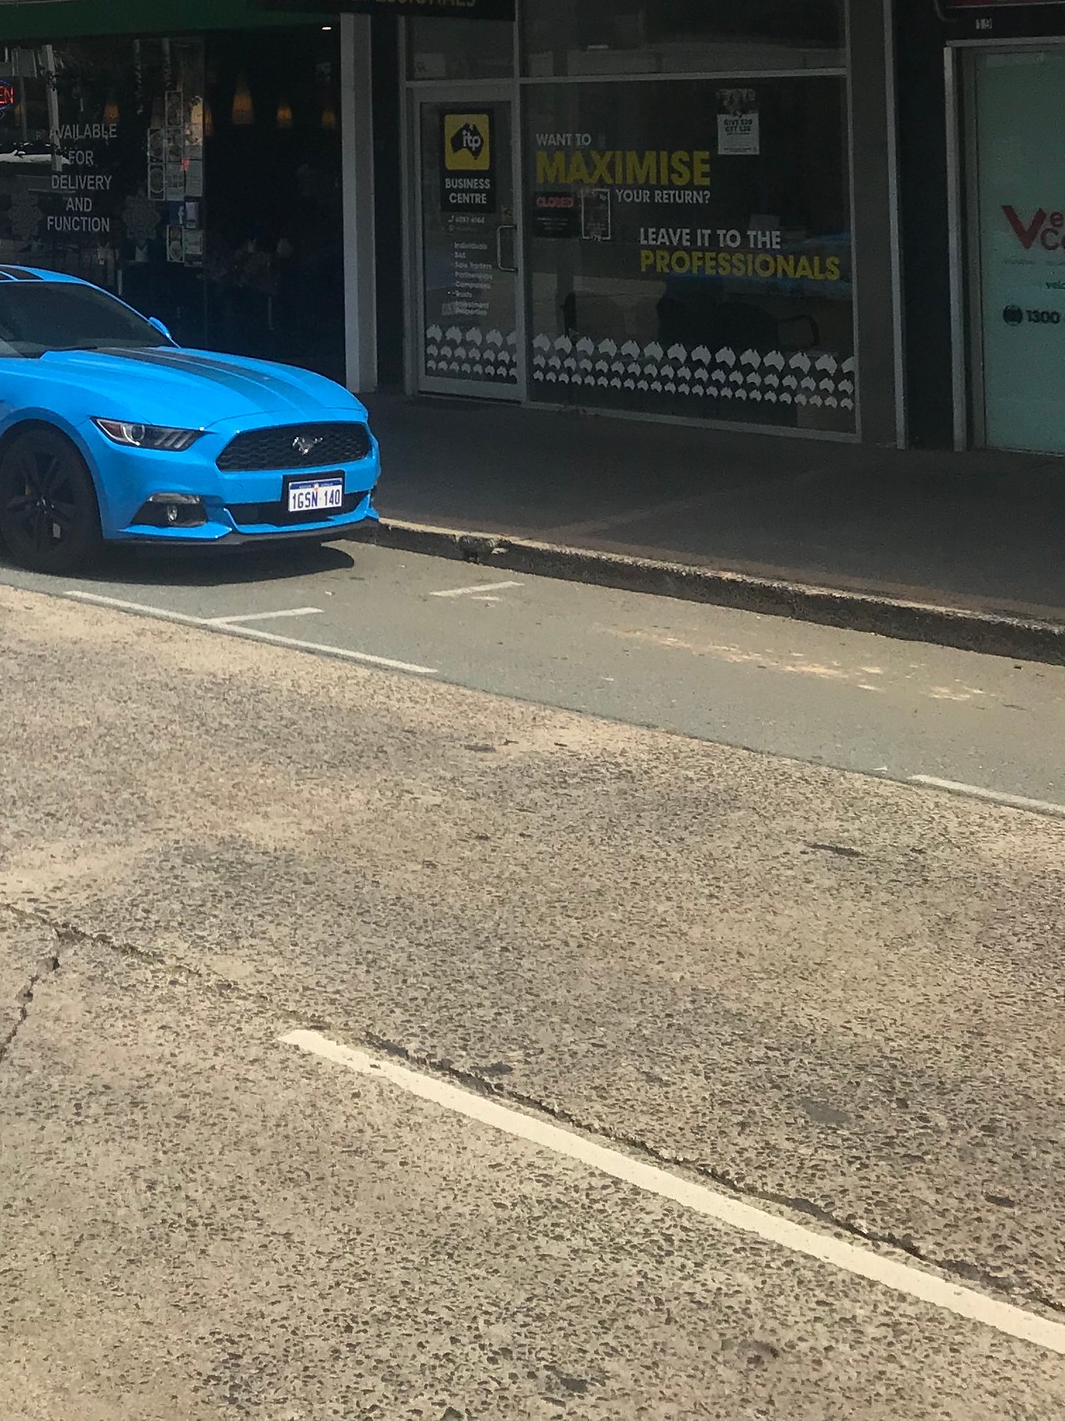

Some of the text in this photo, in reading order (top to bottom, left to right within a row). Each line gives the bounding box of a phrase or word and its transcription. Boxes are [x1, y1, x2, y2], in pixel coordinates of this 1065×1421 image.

[49, 123, 118, 139] AVAILABLE
[462, 129, 481, 151] itp
[535, 133, 592, 147] WANT TO
[68, 150, 94, 165] FOR
[535, 150, 711, 186] MAXIMISE
[51, 174, 113, 190] DELIVERY
[445, 177, 491, 190] BUSINESS
[65, 197, 93, 212] AND
[449, 192, 487, 204] CENTRE
[615, 189, 711, 204] YOUR RETURN?
[47, 216, 110, 232] FUNCTION
[639, 227, 782, 249] LEAVE IT TO THE
[639, 249, 841, 281] PROFESSIONALS
[1025, 309, 1061, 324] 1300
[292, 488, 341, 509] 1GSN 140
